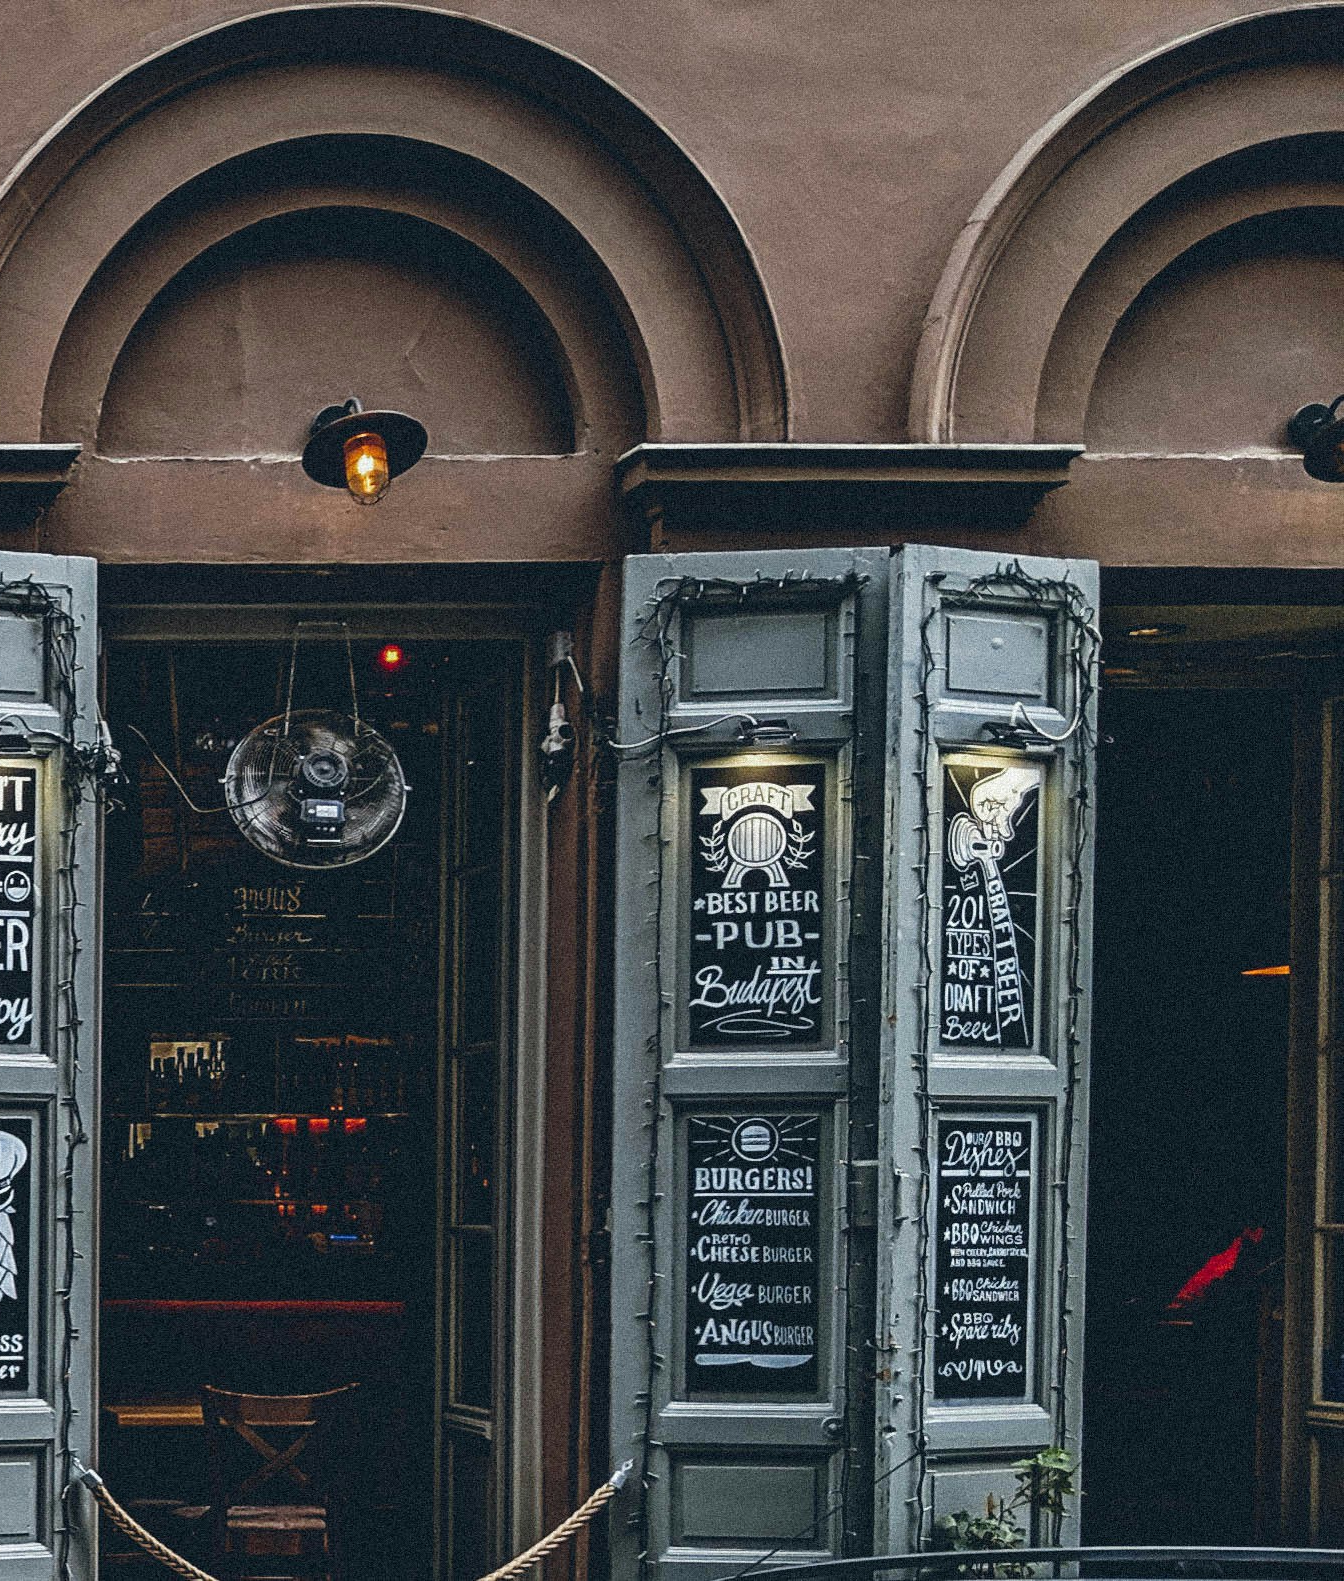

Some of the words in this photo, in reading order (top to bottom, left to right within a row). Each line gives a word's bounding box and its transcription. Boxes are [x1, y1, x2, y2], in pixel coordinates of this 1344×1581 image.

[726, 787, 793, 812] CRAFT
[706, 892, 761, 915] BEST
[765, 891, 819, 913] BEER
[947, 895, 984, 928] 20!
[988, 881, 1014, 949] CRAFT
[712, 920, 802, 949] PUB
[946, 932, 990, 957] TYPES
[771, 956, 806, 970] IN
[959, 960, 980, 980] OF
[689, 959, 821, 1015] Budapest
[945, 983, 994, 1013] DRAFT
[996, 957, 1021, 1027] BEER
[943, 1015, 999, 1041] Beer
[966, 1133, 984, 1145] OUR
[996, 1132, 1021, 1147] BBQ
[694, 1166, 812, 1190] BURGERS!
[997, 1181, 1021, 1199] Pork
[699, 1198, 764, 1225] Chicken
[766, 1209, 810, 1226] BURGER
[951, 1185, 1015, 1215] SANDWICH
[951, 1223, 979, 1244] BBQ
[980, 1220, 1023, 1233] Chicken
[698, 1236, 760, 1262] CHEESE
[763, 1246, 812, 1262] BURGER
[980, 1236, 1023, 1244] WINGS
[698, 1272, 754, 1310] Vega
[759, 1285, 811, 1304] BURGER
[952, 1279, 973, 1301] BBQ
[975, 1276, 1019, 1289] Chicken
[973, 1291, 1019, 1302] SANDWICH
[963, 1313, 993, 1324] BBQ
[698, 1318, 772, 1345] ANGUS
[774, 1325, 813, 1345] BURGER
[950, 1313, 989, 1350] Spare
[992, 1314, 1021, 1346] ribs
